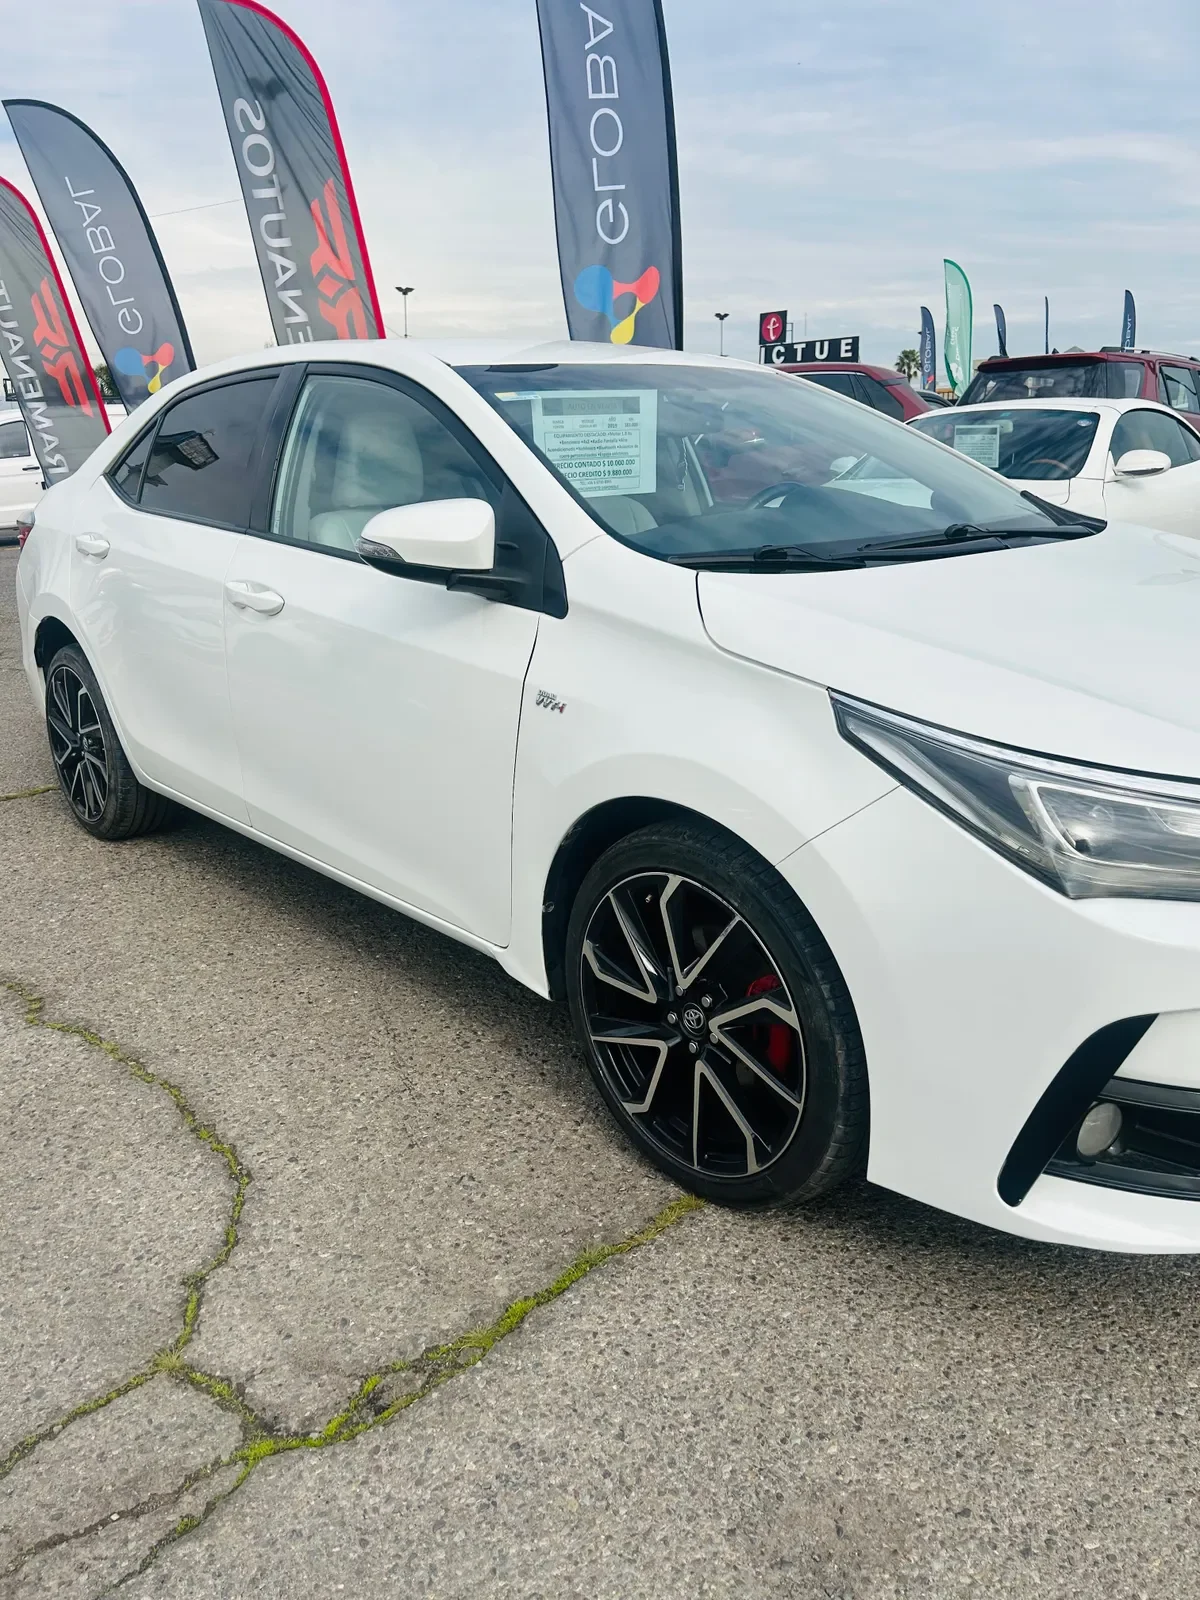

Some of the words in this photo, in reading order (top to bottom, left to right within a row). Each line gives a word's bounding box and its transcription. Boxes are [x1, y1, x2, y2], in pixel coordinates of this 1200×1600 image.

[574, 460, 602, 468] CONTADO
[602, 460, 606, 468] $
[607, 459, 636, 467] 10.000.000
[564, 471, 578, 479] ECIO
[578, 470, 602, 478] CREDITO
